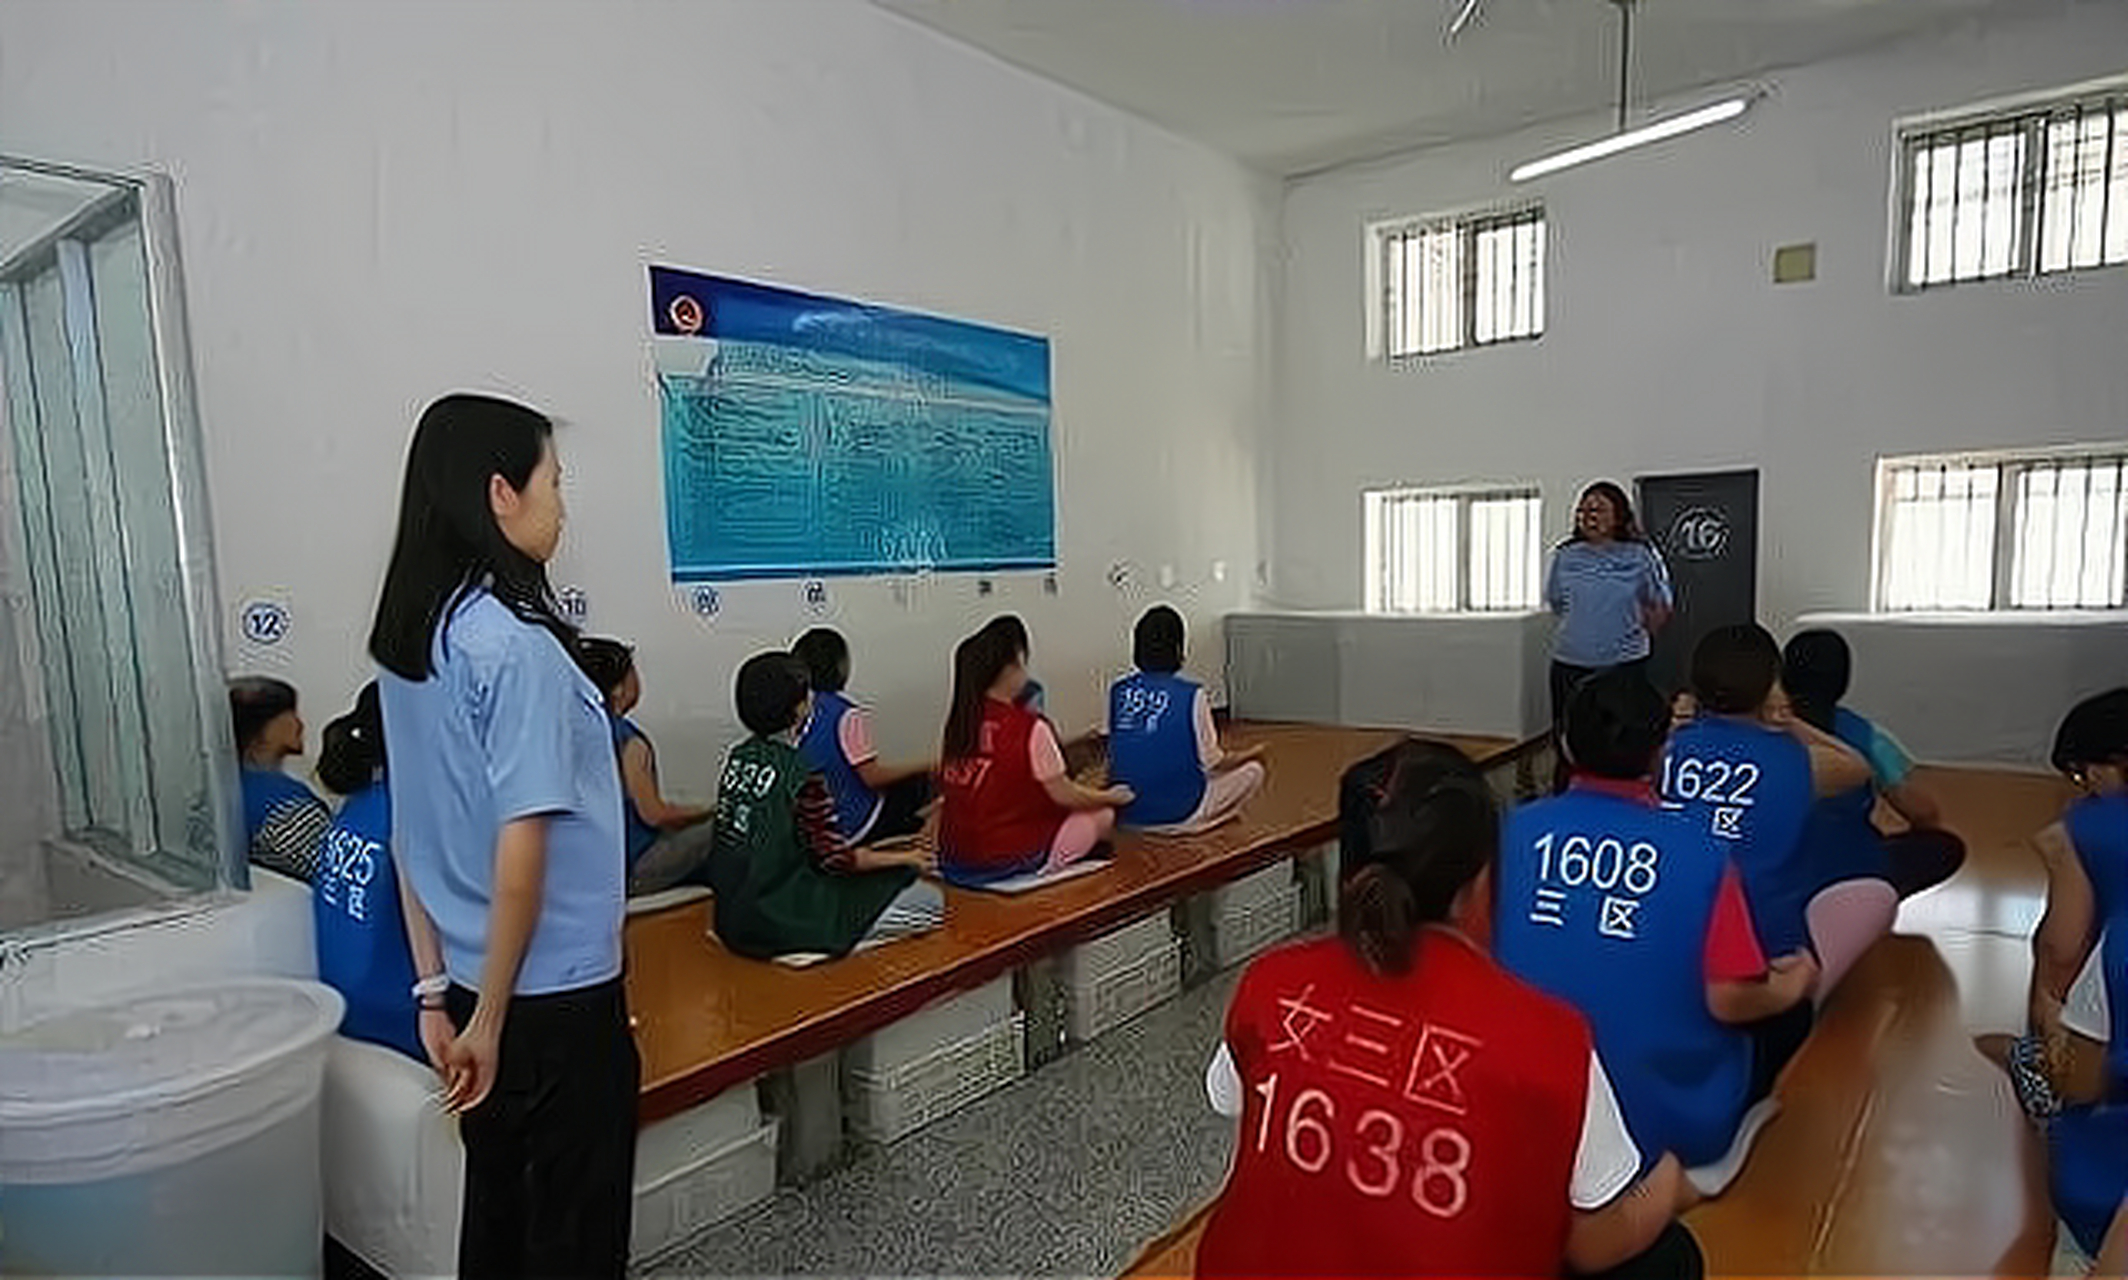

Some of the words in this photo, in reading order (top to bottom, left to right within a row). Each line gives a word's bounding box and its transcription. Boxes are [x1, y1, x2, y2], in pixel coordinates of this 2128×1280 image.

[1681, 516, 1721, 550] 16
[1661, 756, 1760, 807] 1622
[1534, 832, 1658, 894] 1608
[1267, 983, 1483, 1117] 女三区
[1255, 1072, 1472, 1218] 1638
